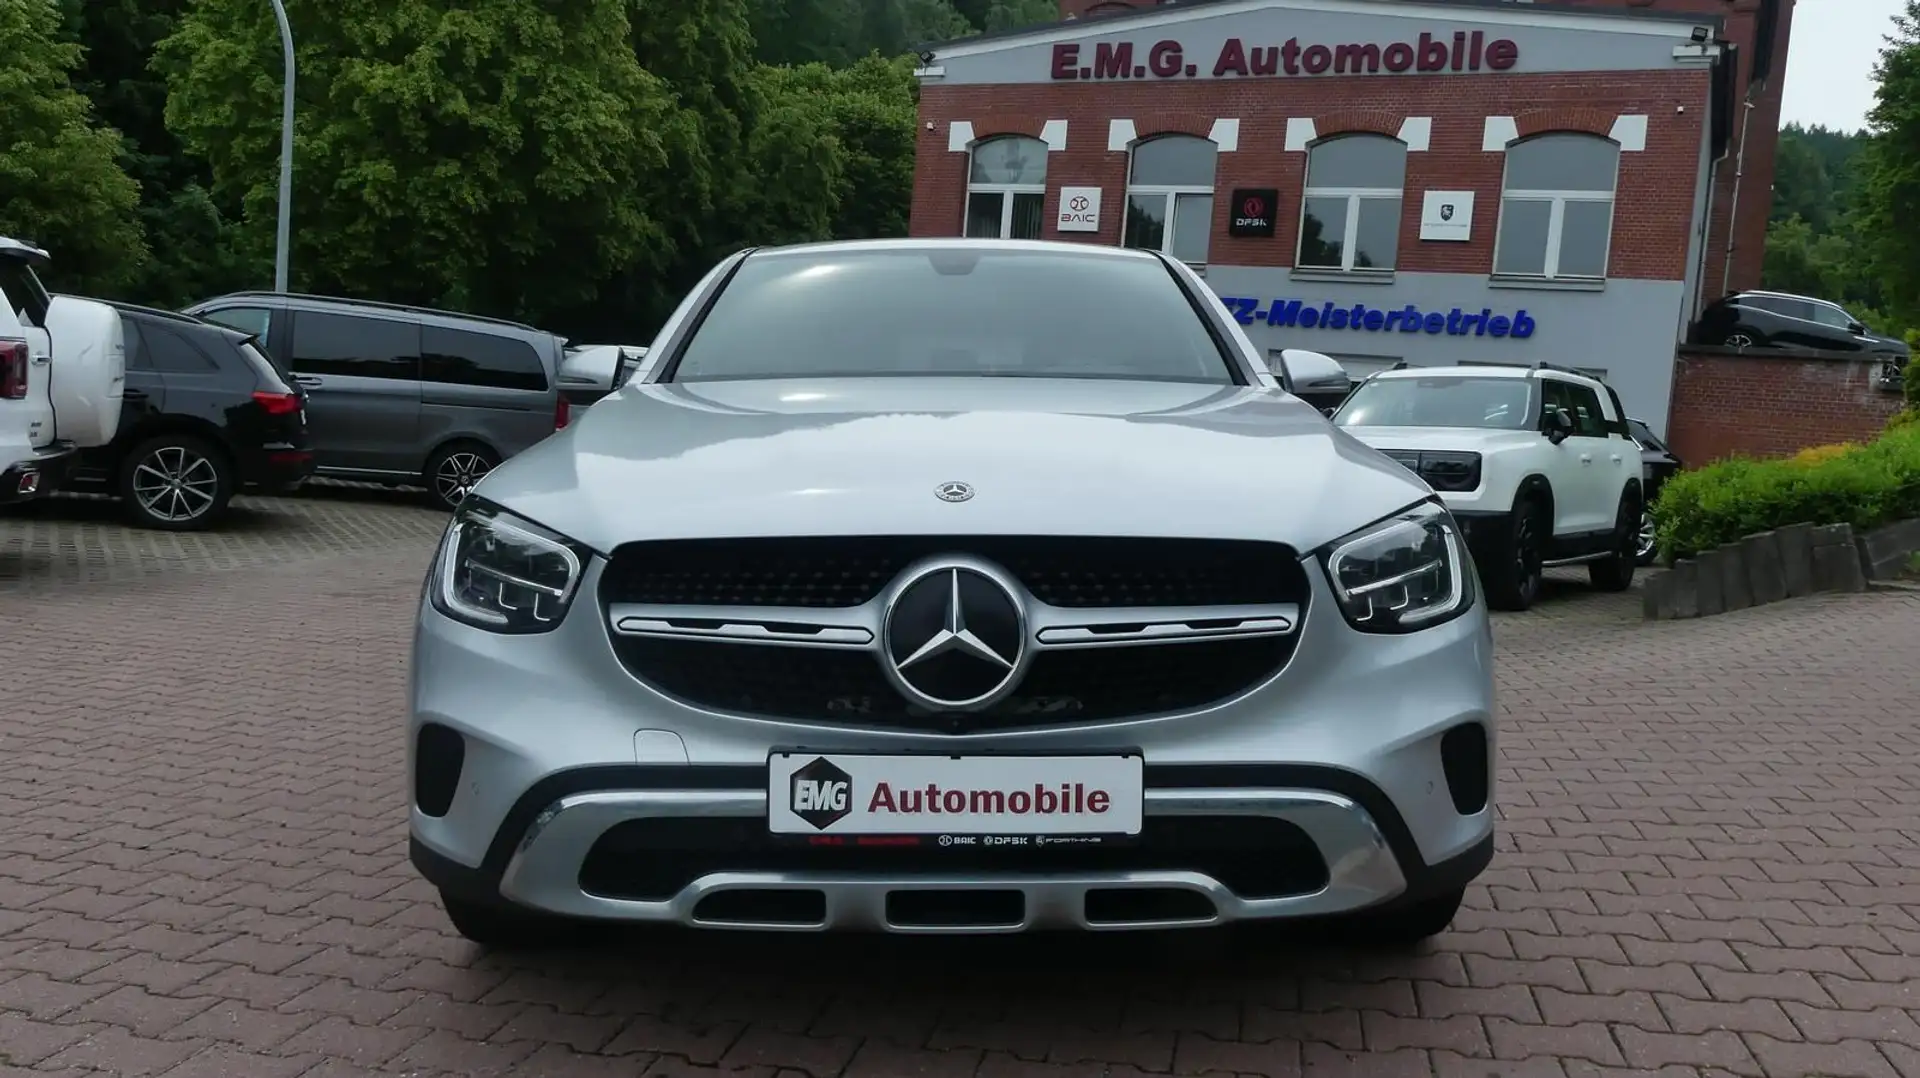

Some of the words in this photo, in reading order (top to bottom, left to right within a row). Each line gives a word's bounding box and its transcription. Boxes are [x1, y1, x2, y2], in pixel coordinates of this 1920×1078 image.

[1050, 40, 1197, 79] E.M.G.
[1212, 31, 1519, 77] Automobile
[1060, 213, 1096, 223] BAIC
[794, 779, 848, 811] EMG
[867, 782, 1111, 814] Automobile
[953, 836, 976, 844] BAIC
[994, 836, 1028, 845] DFSK
